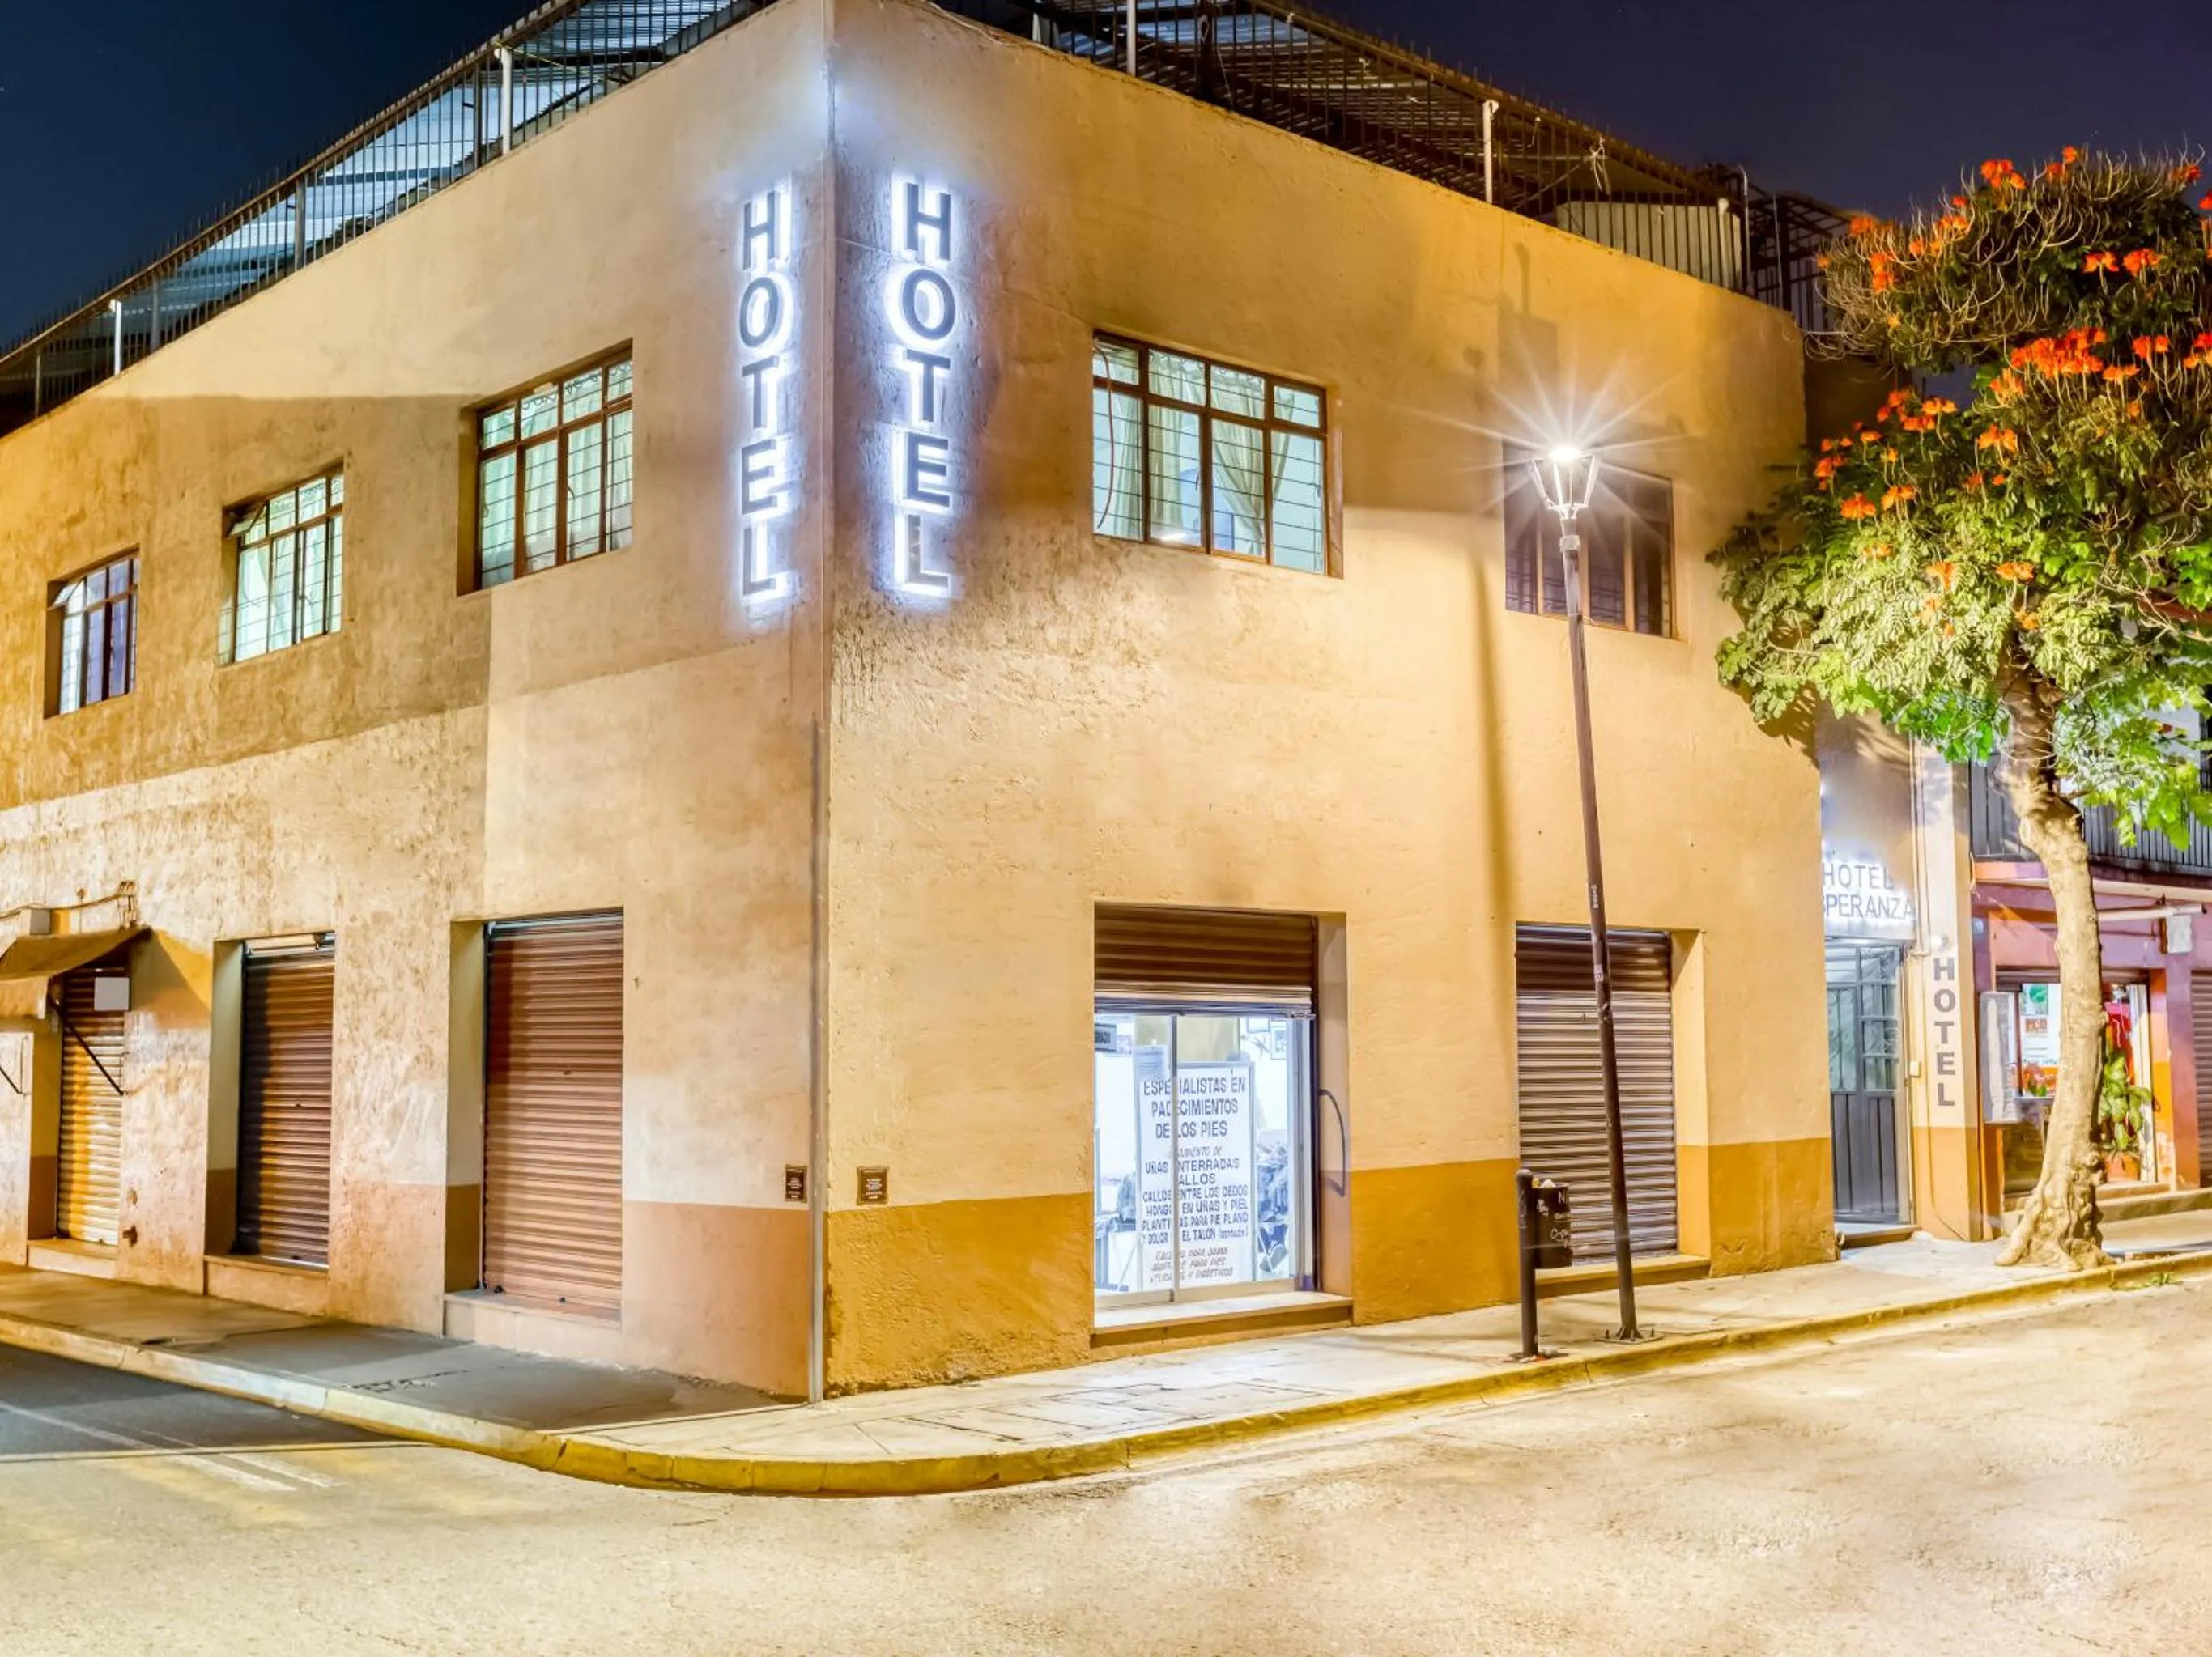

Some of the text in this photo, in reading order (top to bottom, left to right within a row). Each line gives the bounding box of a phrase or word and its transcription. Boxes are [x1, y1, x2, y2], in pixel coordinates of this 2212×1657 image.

[738, 191, 780, 596] HOTEL
[902, 182, 957, 590] HOTEL
[1823, 862, 1895, 890] HOTEL
[1933, 957, 1956, 1107] HOTEL
[1143, 1077, 1245, 1096] ESPEIALISTAS EN
[1151, 1098, 1239, 1117] PADCIMIENTOS
[1155, 1122, 1171, 1139] DE
[1201, 1120, 1227, 1137] PIES
[1145, 1157, 1240, 1175] UÑAS NTERRADAS
[1179, 1172, 1216, 1186] ALLOS
[1180, 1187, 1202, 1200] NTRE
[1182, 1201, 1194, 1214] EN
